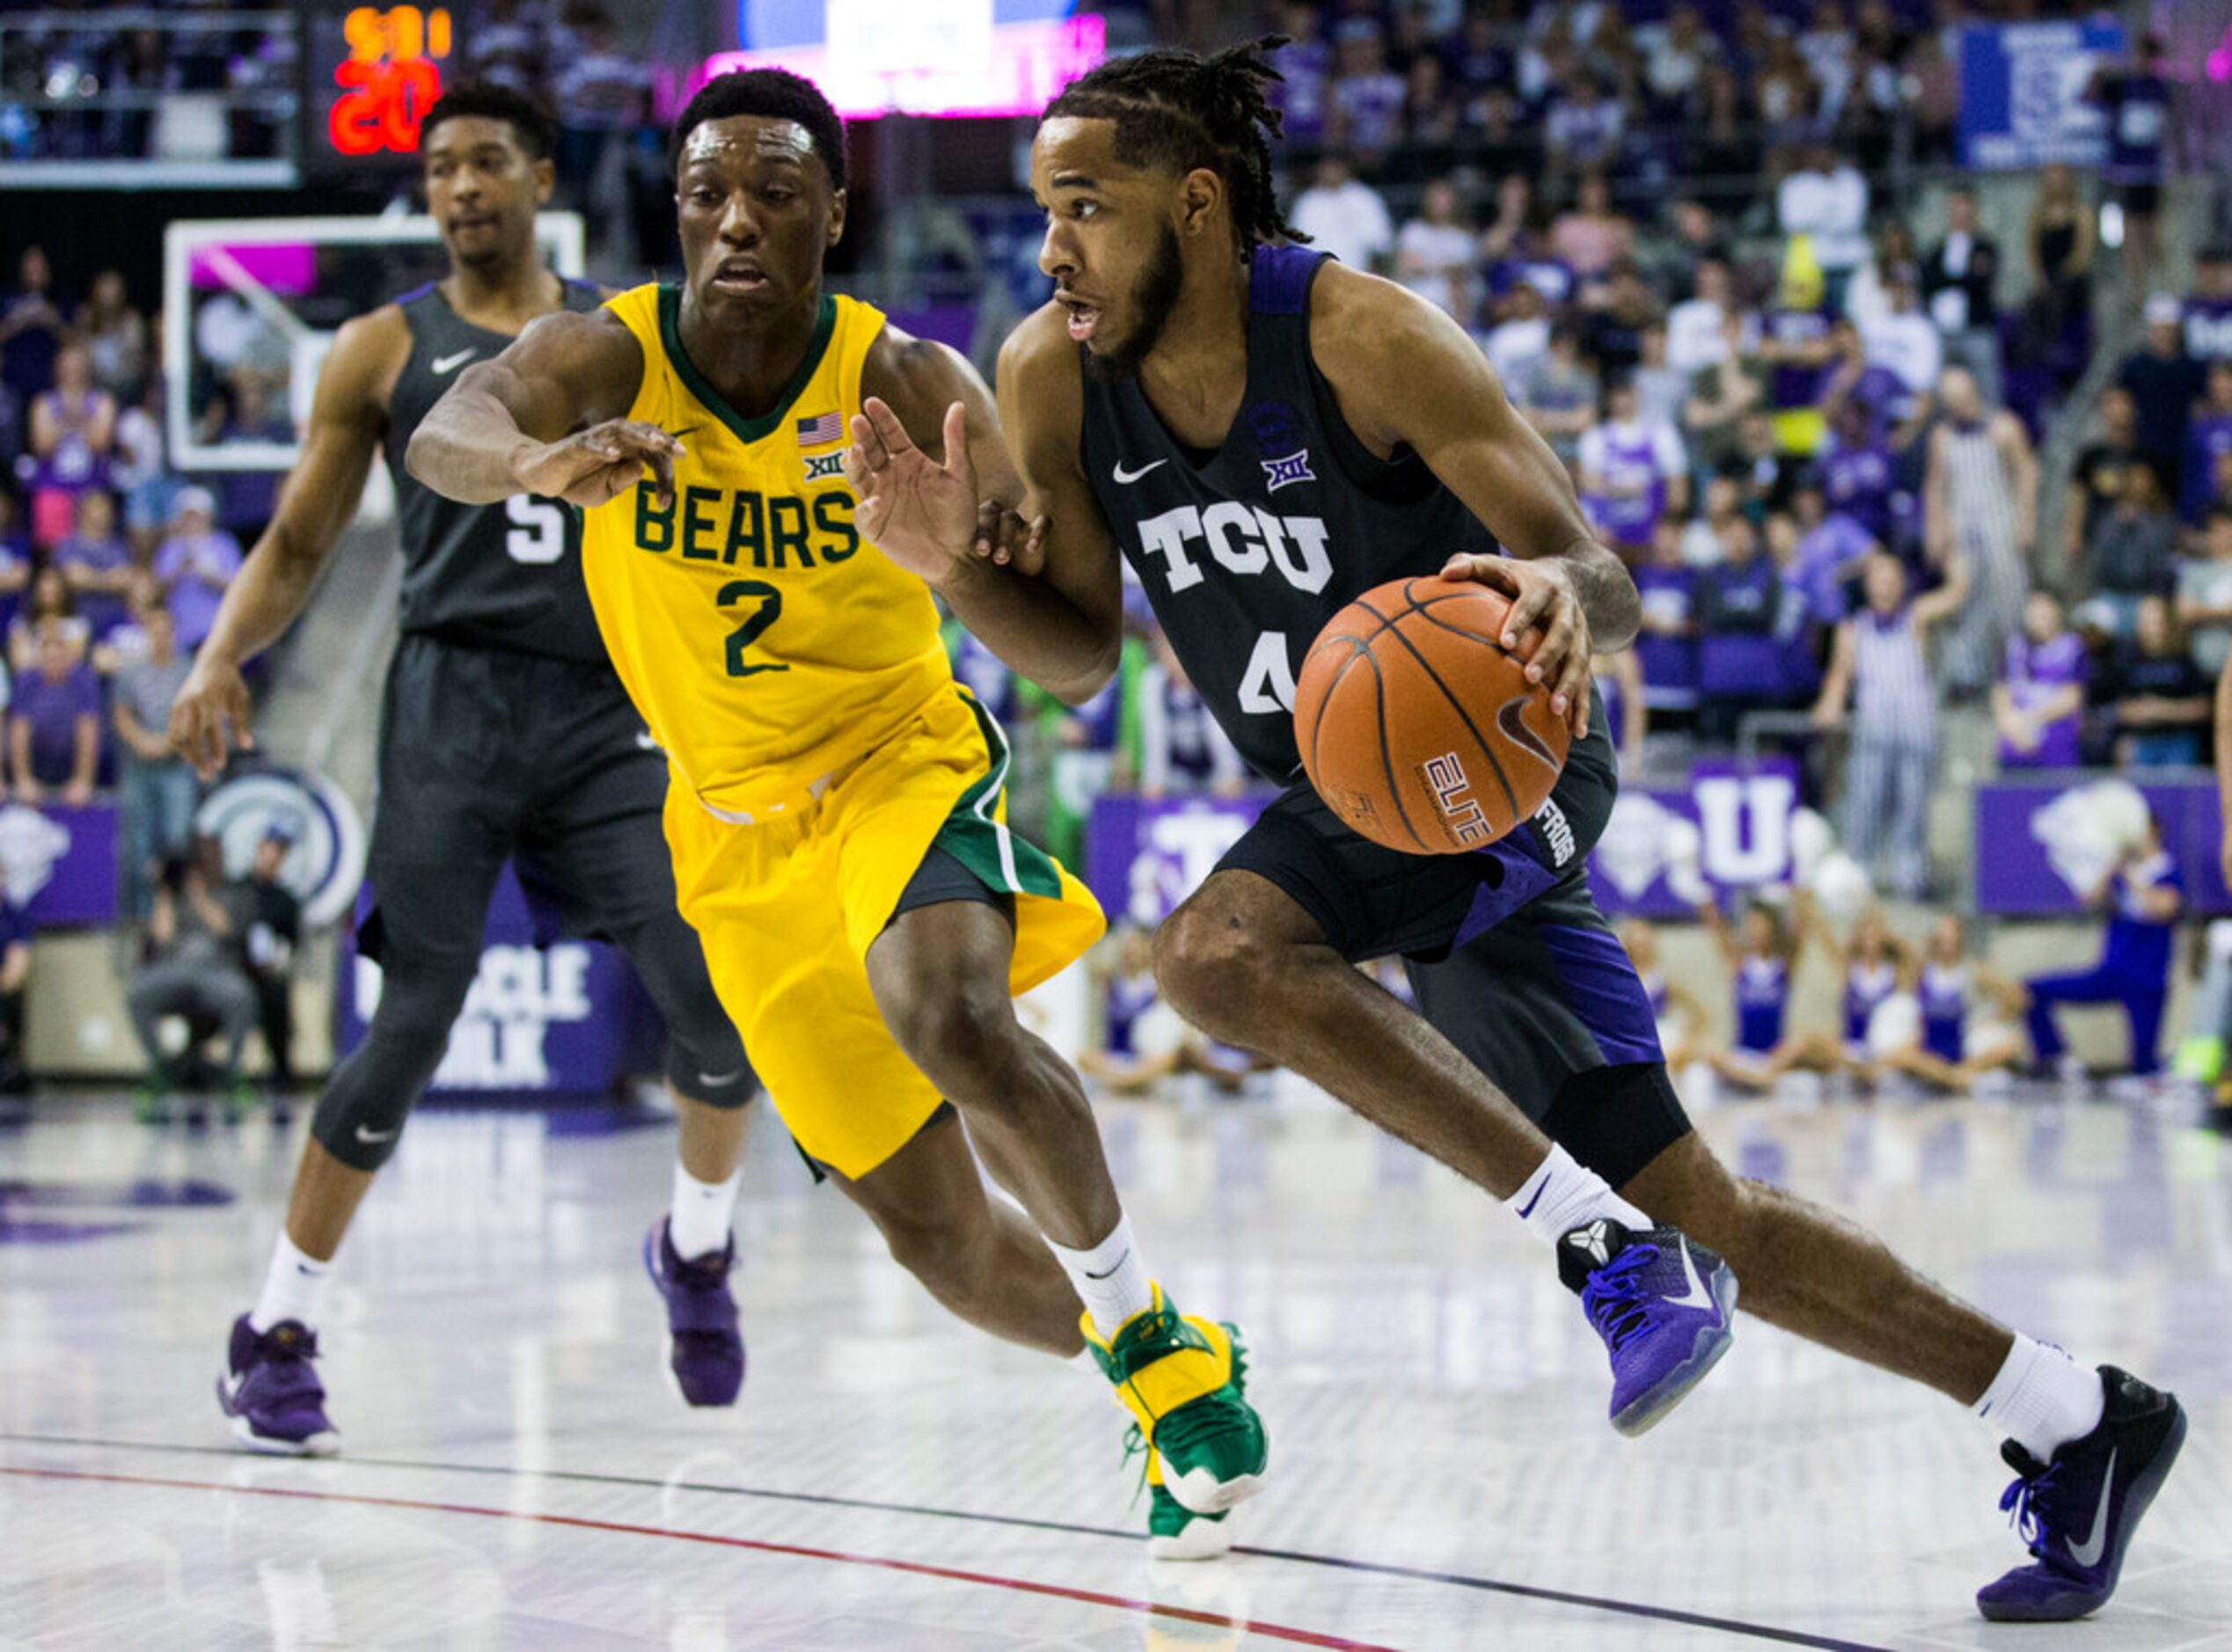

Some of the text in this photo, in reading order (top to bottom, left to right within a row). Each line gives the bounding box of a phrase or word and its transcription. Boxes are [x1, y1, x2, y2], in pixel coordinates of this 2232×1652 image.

[803, 450, 845, 481] XII
[1263, 451, 1313, 489] XII
[635, 479, 860, 567] BEARS
[1138, 501, 1334, 596] TCU
[716, 580, 789, 677] 2
[1237, 631, 1297, 714] 4
[1423, 751, 1494, 844] ELITE
[1694, 775, 1796, 881] U
